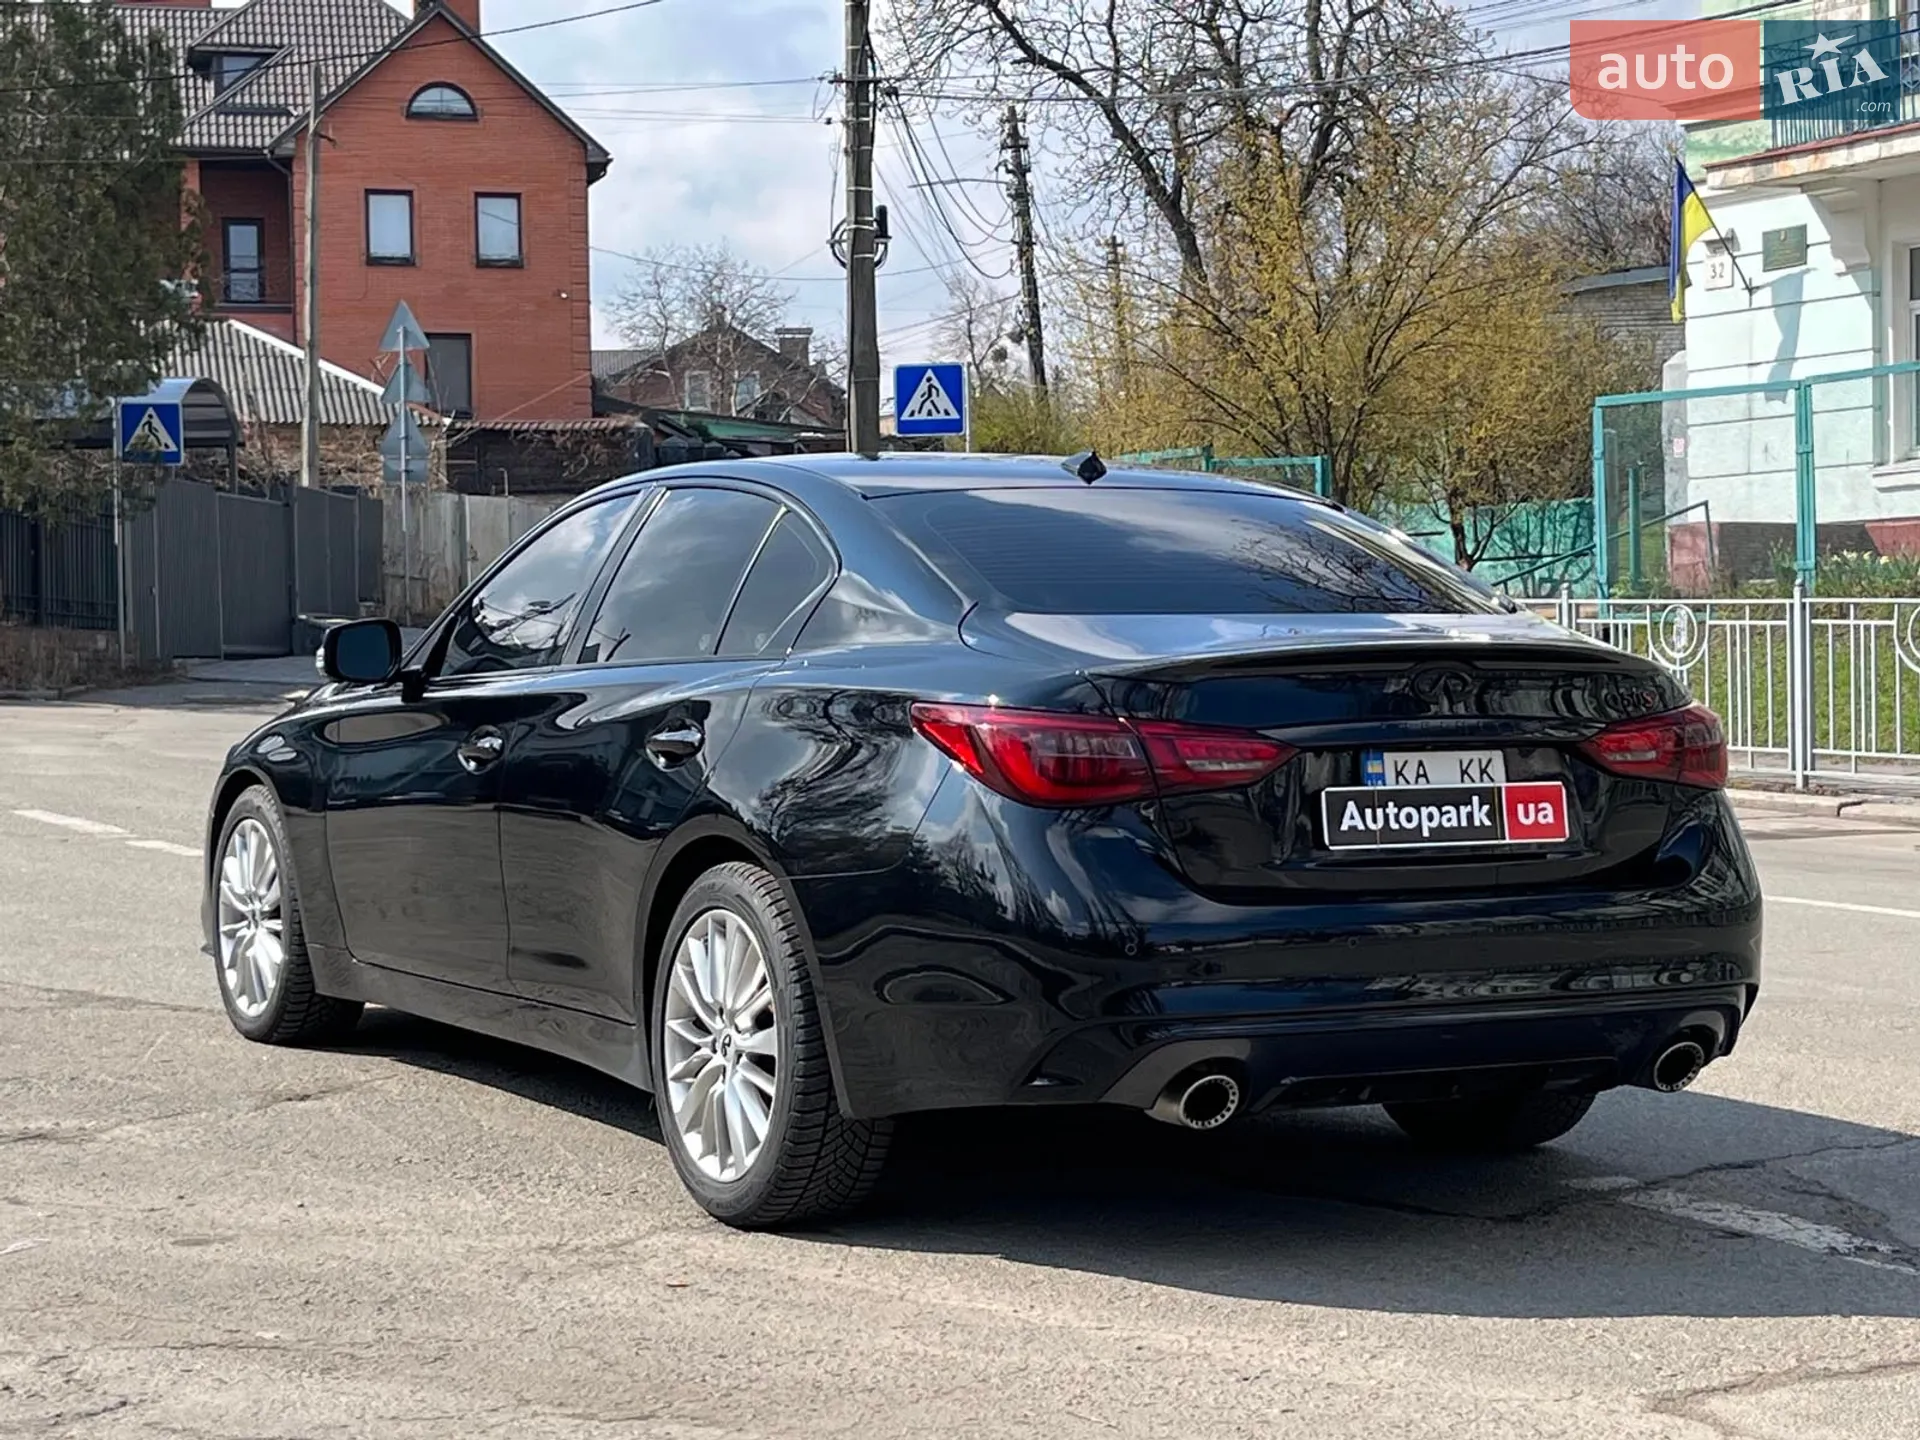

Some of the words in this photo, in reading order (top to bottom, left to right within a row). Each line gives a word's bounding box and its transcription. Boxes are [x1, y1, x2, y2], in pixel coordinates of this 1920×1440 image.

[1394, 759, 1429, 785] KA
[1460, 758, 1494, 784] KK
[1340, 795, 1492, 837] Autopark
[1517, 802, 1554, 825] ua
